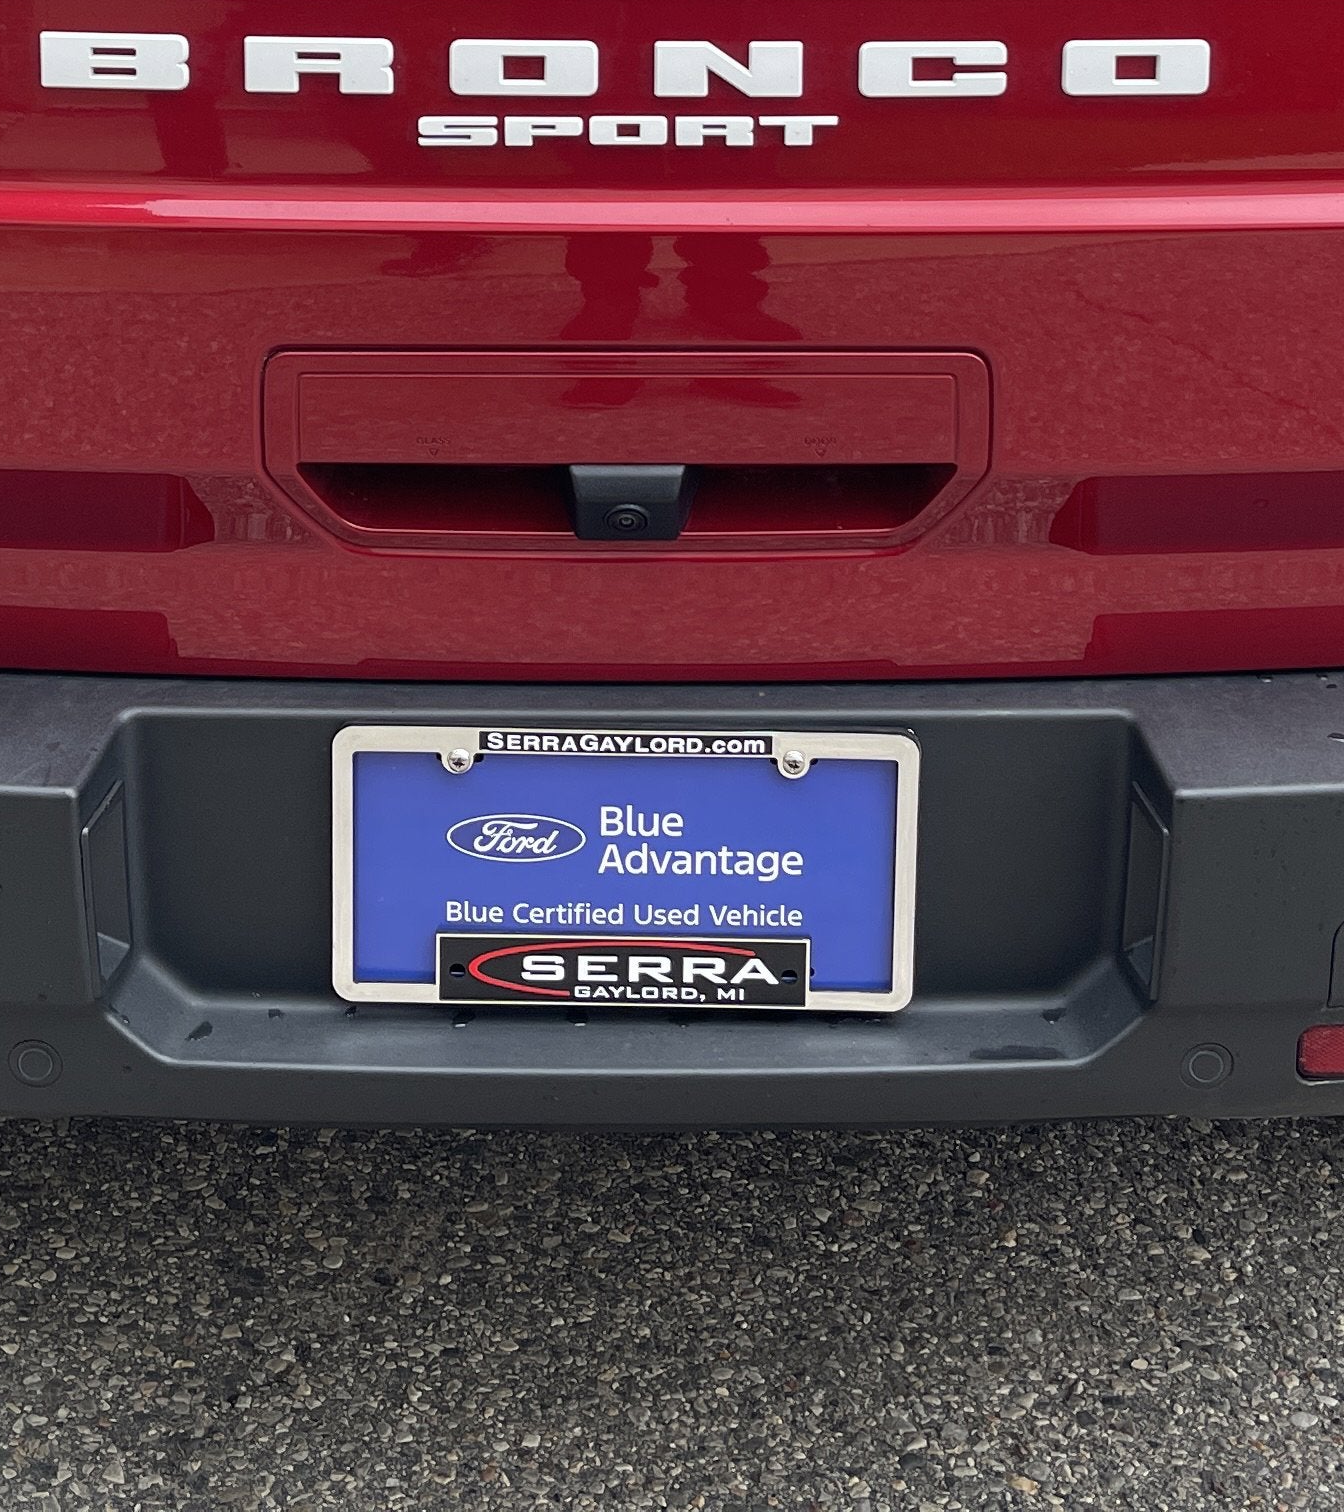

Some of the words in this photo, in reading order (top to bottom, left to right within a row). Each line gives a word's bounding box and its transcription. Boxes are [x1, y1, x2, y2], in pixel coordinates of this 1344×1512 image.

[38, 29, 1212, 97] BRONCO
[417, 115, 840, 147] SPORT
[486, 731, 766, 755] SERRAGAYLORD.com
[599, 804, 685, 837] Blue
[472, 819, 560, 856] Ford
[597, 842, 805, 882] Advantage
[445, 900, 504, 924] Blue
[512, 902, 625, 926] Certified
[633, 903, 700, 926] Used
[708, 904, 804, 927] Vehicle
[520, 954, 780, 985] SERRA
[573, 985, 706, 1003] GAYLORD,
[717, 988, 745, 1001] MI
